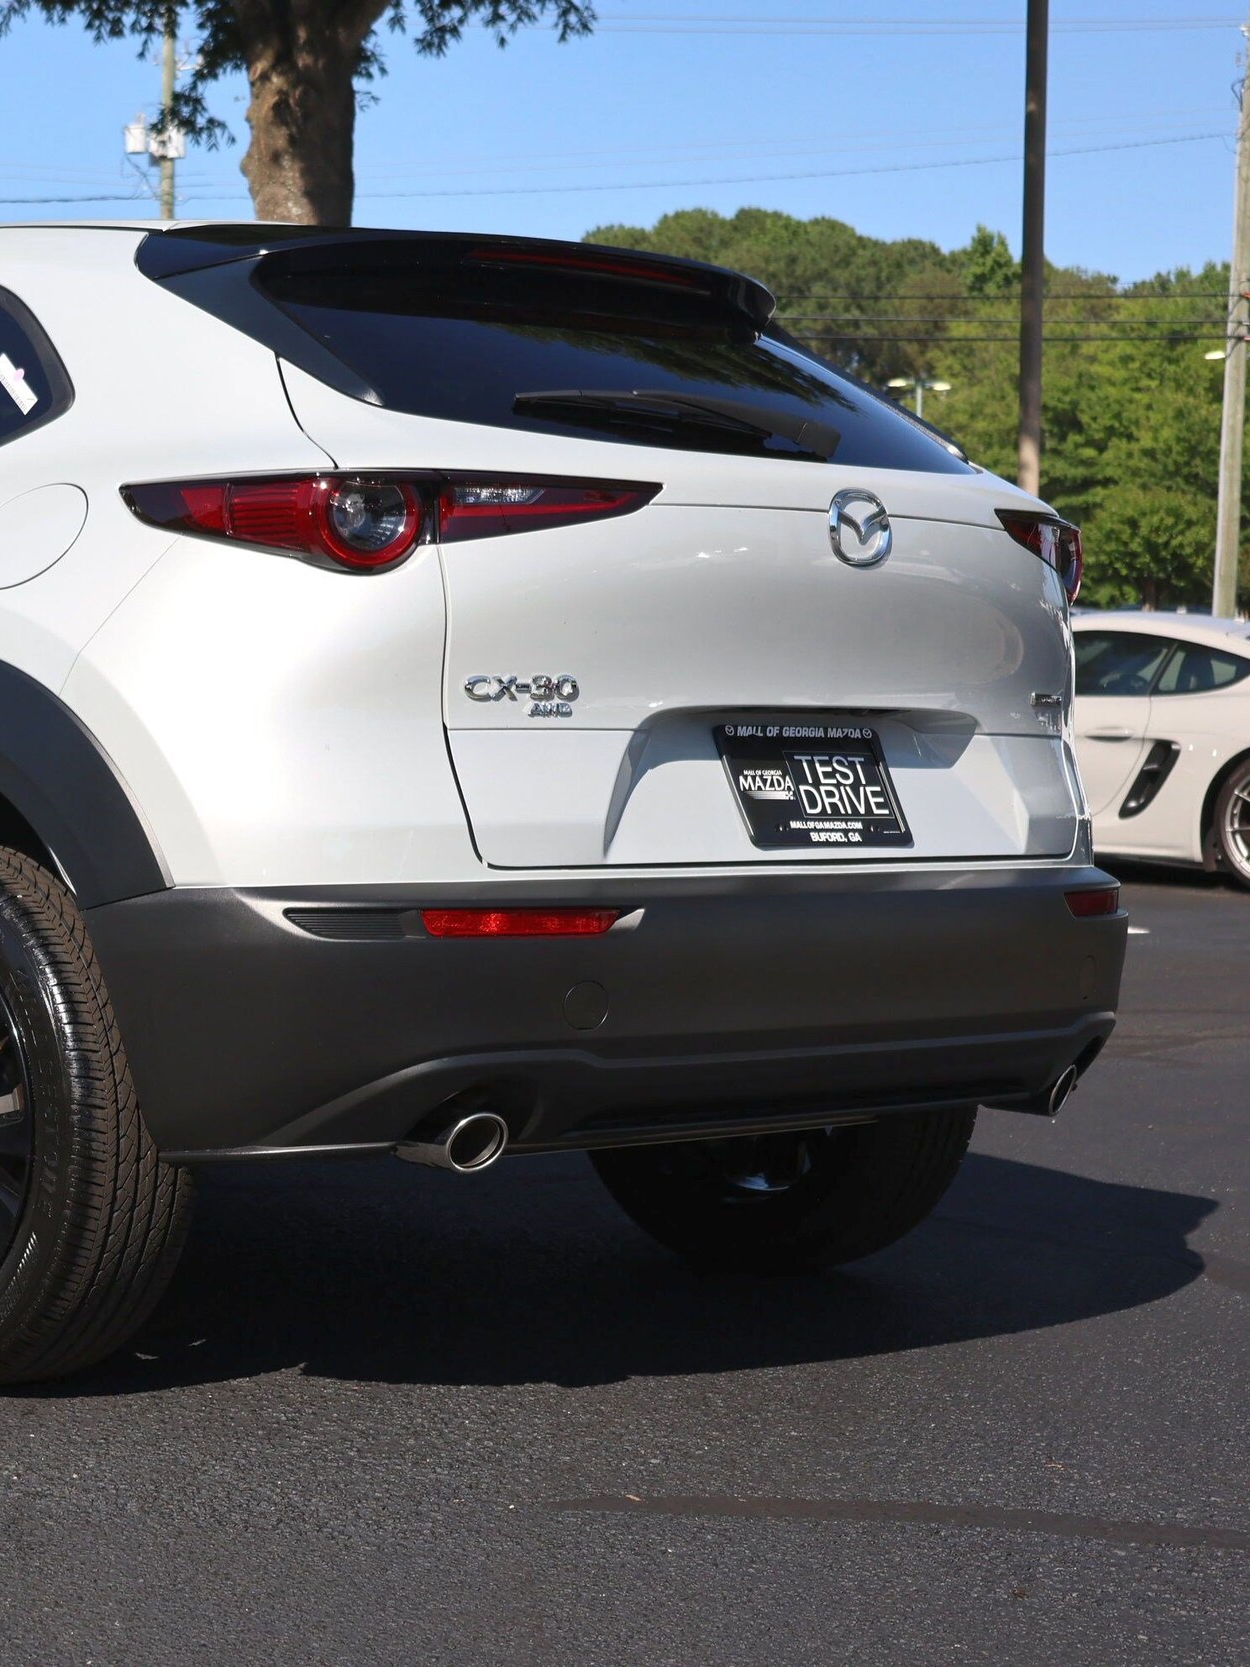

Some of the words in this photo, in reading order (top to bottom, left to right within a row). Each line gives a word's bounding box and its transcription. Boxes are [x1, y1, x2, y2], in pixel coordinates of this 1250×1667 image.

[464, 674, 580, 703] CX-30
[737, 726, 764, 737] MALL
[766, 726, 780, 737] OF
[782, 727, 825, 738] GEORGIA
[827, 728, 861, 739] MAZDA
[794, 755, 865, 784] TEST
[739, 775, 794, 792] MAZDA
[799, 785, 890, 815] DRIVE
[790, 820, 863, 830] MALLOFGAMAZDA.COM
[810, 832, 848, 843] BUFORD,
[848, 832, 863, 842] GA
